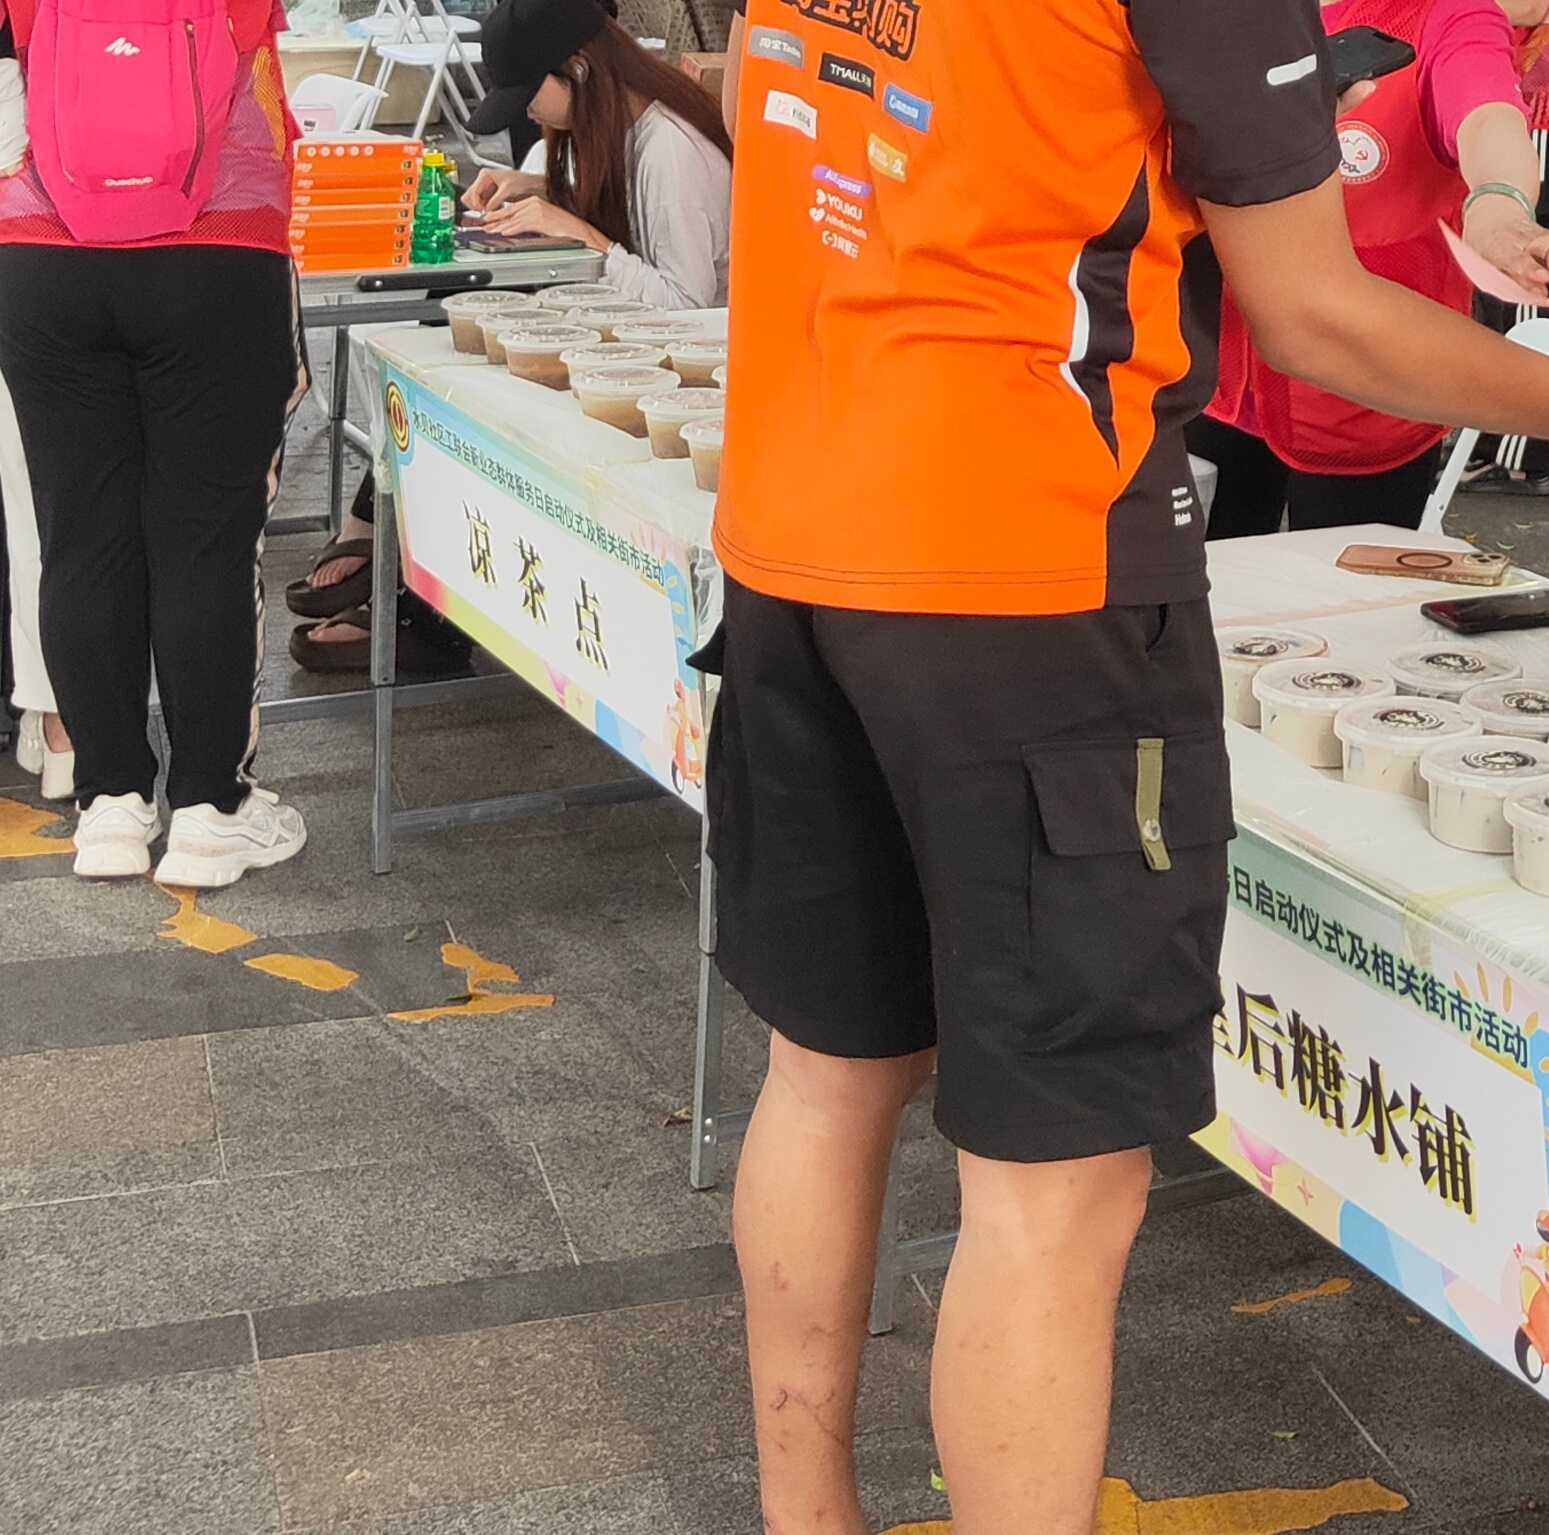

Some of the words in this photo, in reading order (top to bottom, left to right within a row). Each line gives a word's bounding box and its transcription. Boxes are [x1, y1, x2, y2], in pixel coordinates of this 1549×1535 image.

[826, 195, 864, 222] YOUKU
[462, 498, 610, 674] 凉茶点
[1226, 866, 1528, 1068] 日启动仪式及相关街市活动
